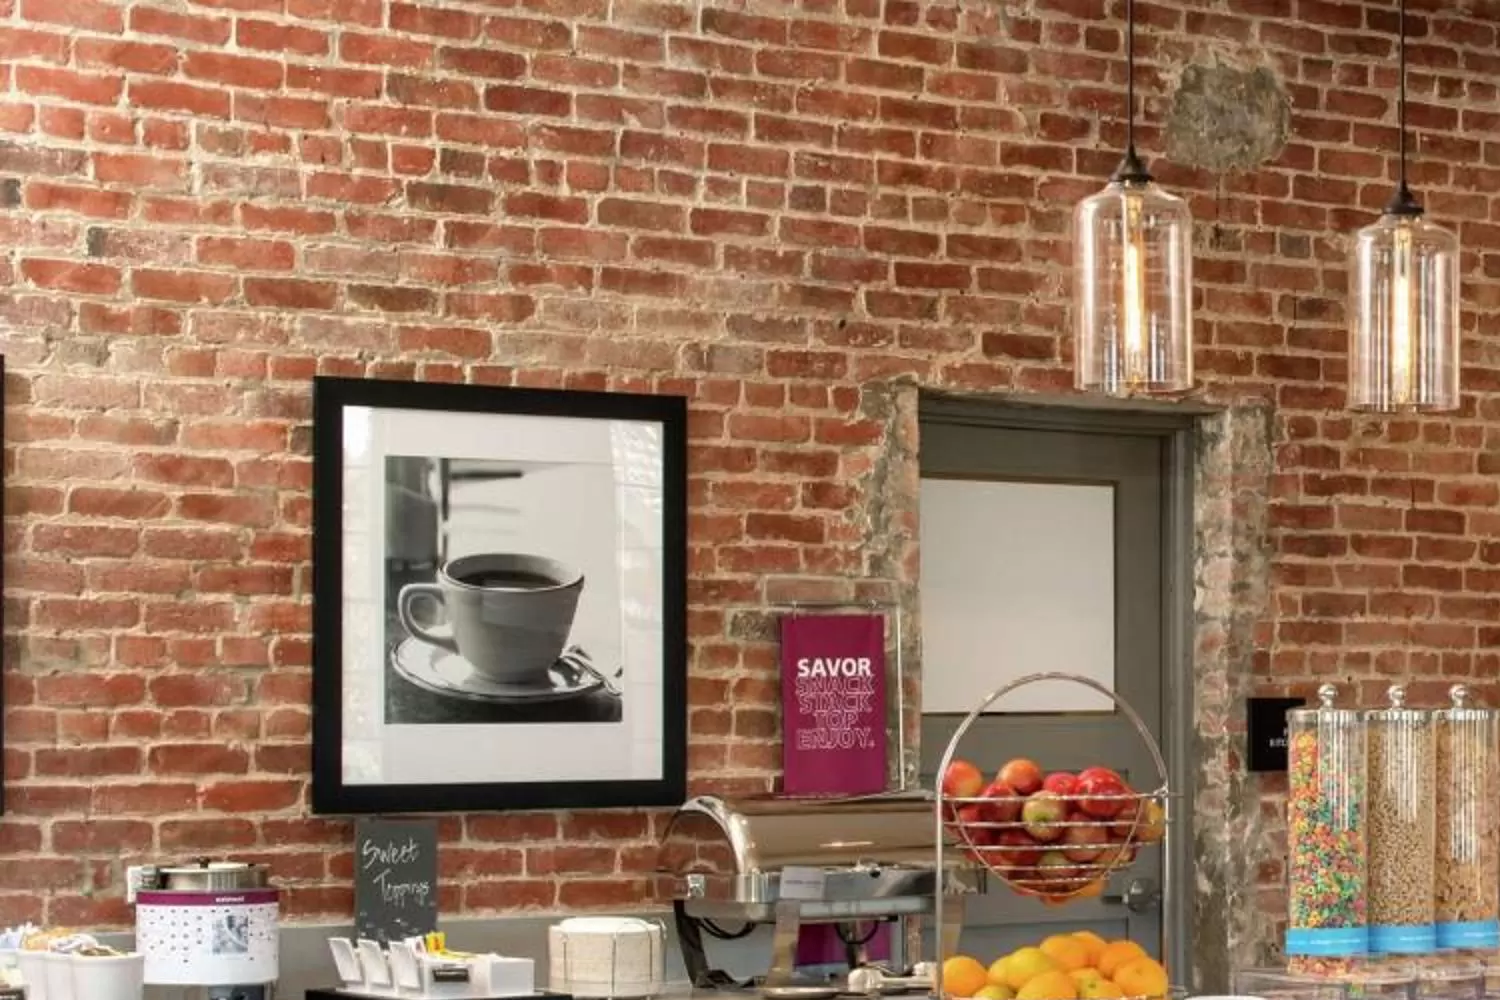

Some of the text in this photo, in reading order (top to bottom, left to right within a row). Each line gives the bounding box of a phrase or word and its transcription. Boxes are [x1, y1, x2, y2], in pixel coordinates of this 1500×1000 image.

[797, 657, 871, 677] SAVOR
[796, 676, 874, 694] SNACK
[799, 692, 873, 714] STACK
[813, 710, 859, 729] TOP
[796, 727, 875, 750] ENJOY.
[362, 836, 420, 869] Sweet
